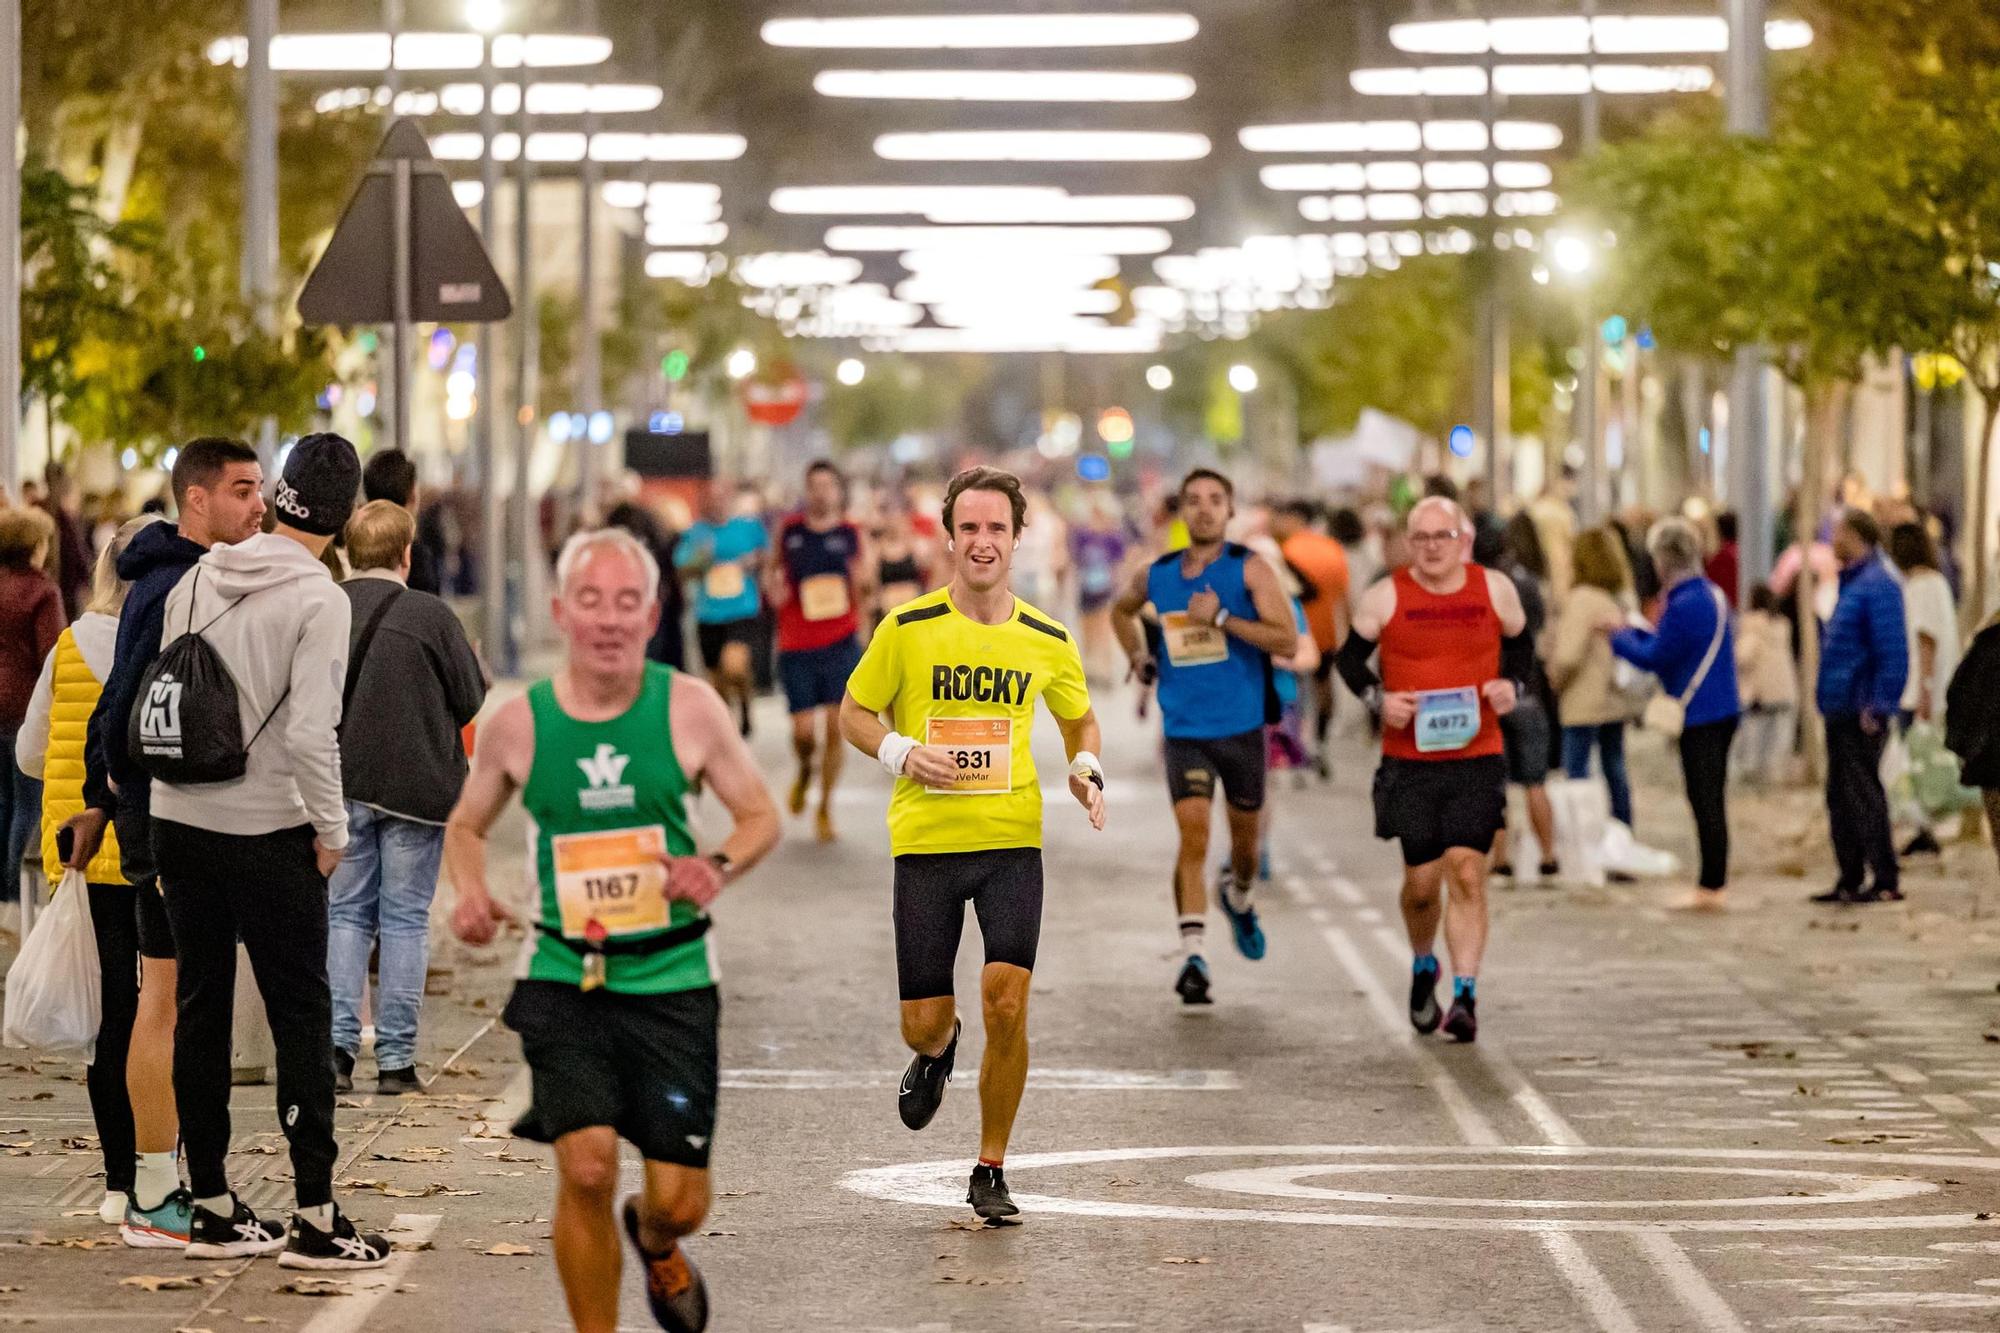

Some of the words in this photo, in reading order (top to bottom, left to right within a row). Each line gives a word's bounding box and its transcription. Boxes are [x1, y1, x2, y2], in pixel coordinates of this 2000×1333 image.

[932, 664, 1033, 706] ROCKY
[1428, 713, 1469, 729] 4972
[947, 750, 991, 769] 631
[584, 873, 639, 900] 1167
